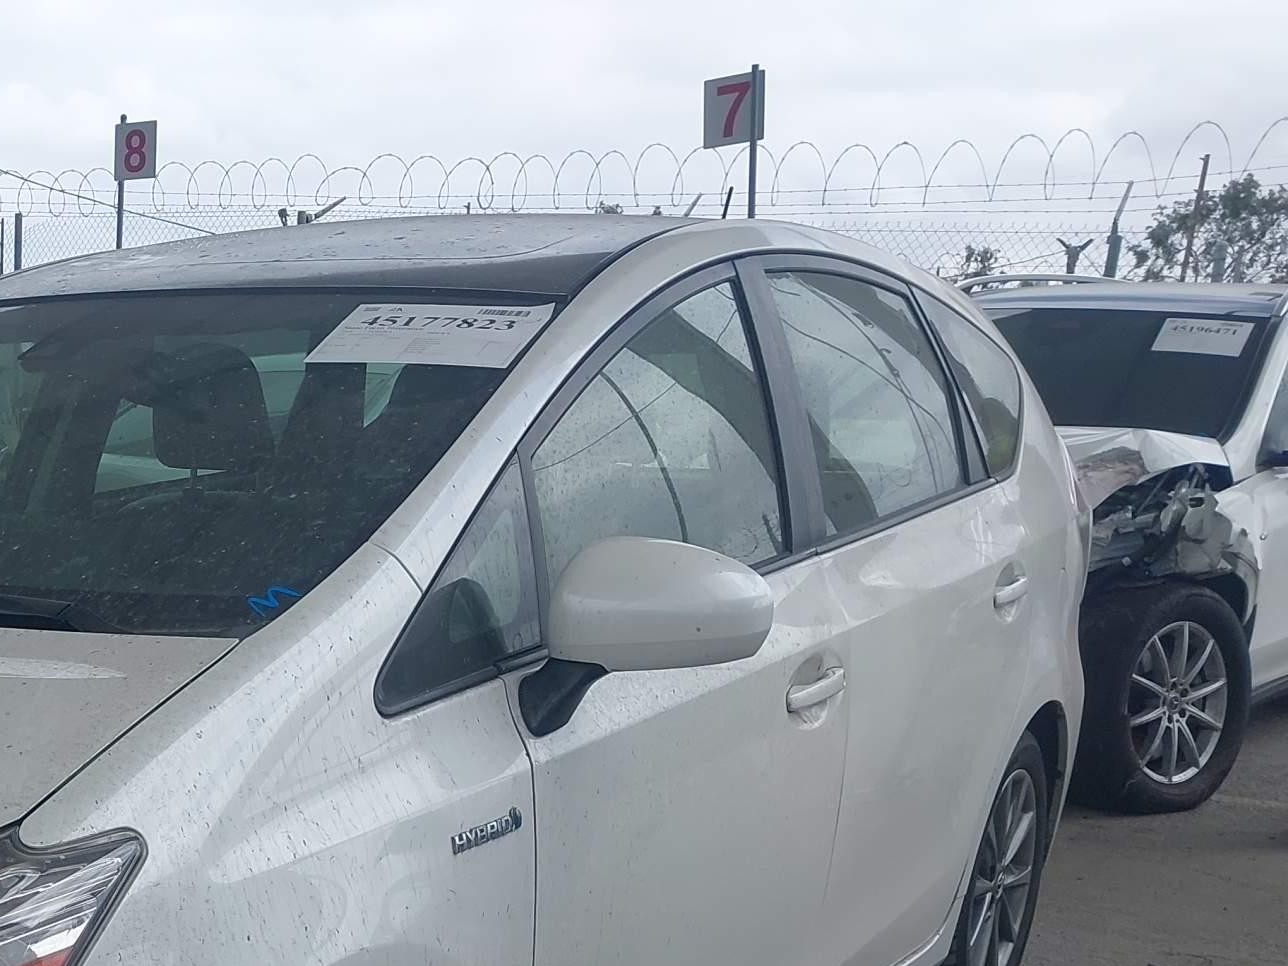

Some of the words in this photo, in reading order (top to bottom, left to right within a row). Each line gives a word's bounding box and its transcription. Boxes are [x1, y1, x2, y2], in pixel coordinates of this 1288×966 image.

[717, 81, 751, 138] 7
[124, 129, 146, 172] 8
[360, 315, 517, 331] 45177823
[451, 815, 513, 855] HYBRID
